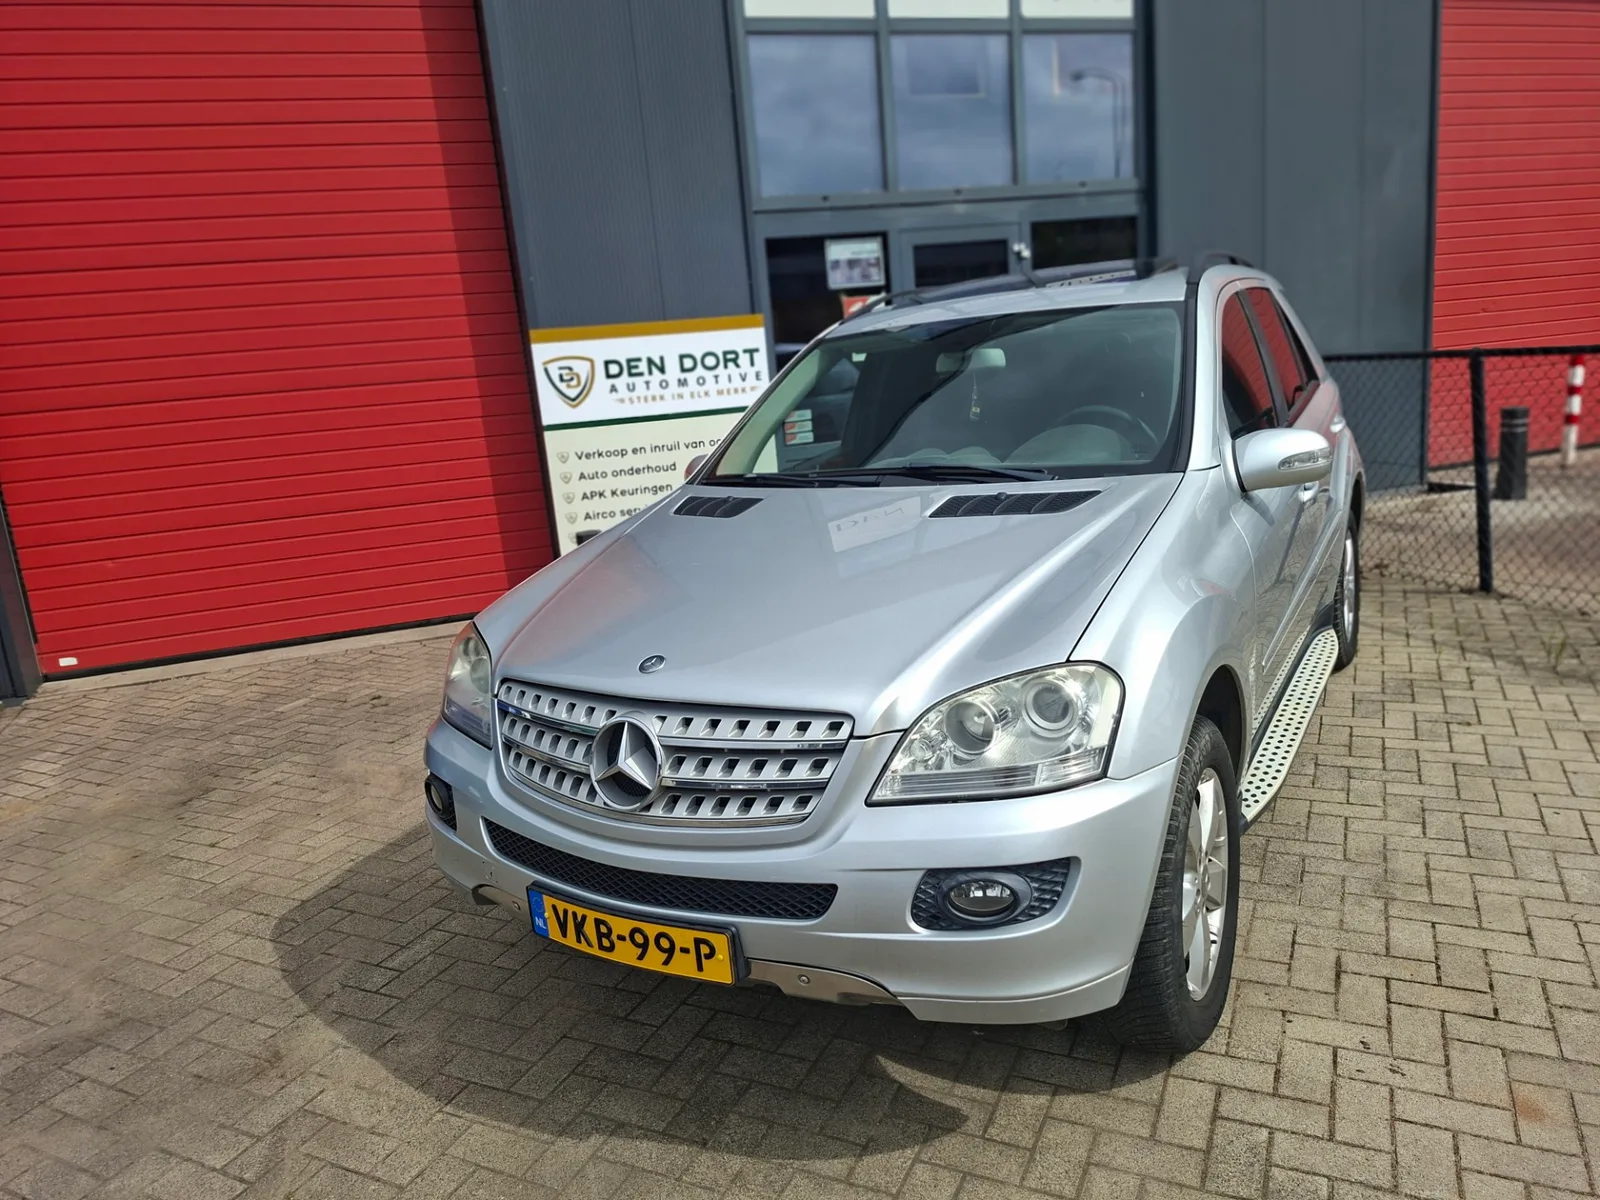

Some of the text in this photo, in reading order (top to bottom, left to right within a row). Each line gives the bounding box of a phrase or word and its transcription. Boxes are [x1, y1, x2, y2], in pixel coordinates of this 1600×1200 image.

[603, 347, 760, 380] DEN DORT
[609, 370, 763, 395] AUTOMOTIVE
[628, 386, 748, 405] STERK IN ELK MERK
[574, 447, 628, 462] Verkoop
[631, 446, 647, 456] en
[649, 440, 681, 454] inruil
[683, 439, 706, 450] van
[578, 461, 677, 482] Auto onderhoud
[580, 482, 673, 502] APK Keuringen
[583, 510, 616, 522] Airco
[534, 916, 548, 930] NL
[551, 903, 717, 973] VKB-99-P
